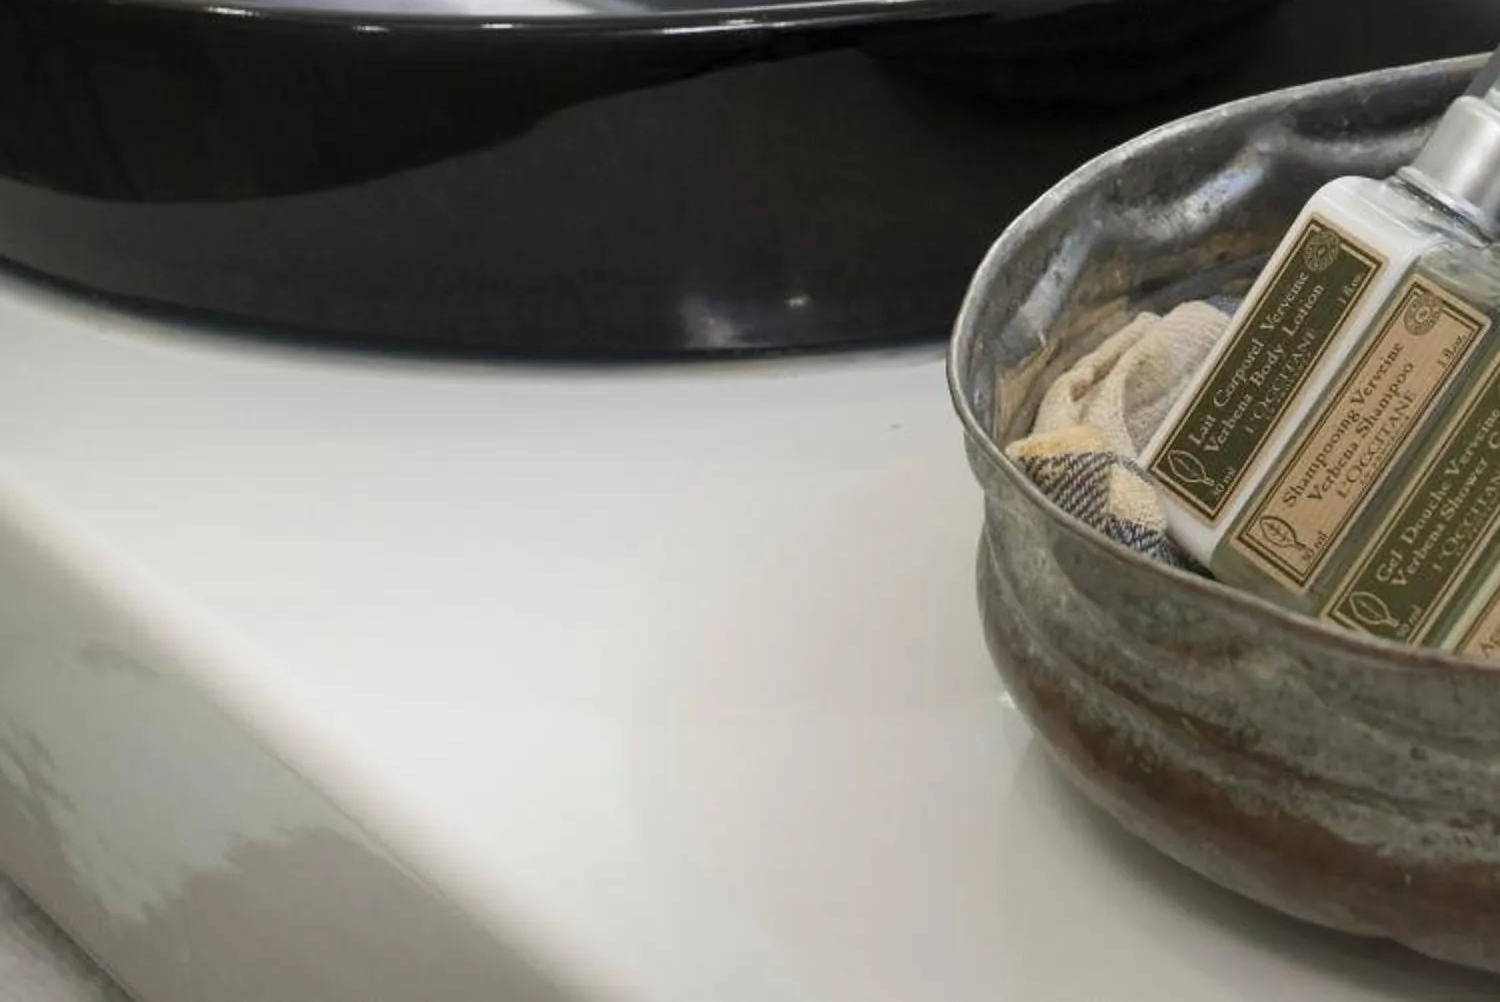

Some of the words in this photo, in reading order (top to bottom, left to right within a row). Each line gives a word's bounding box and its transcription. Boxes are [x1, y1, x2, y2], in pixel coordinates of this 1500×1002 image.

[1204, 392, 1251, 454] Verbena
[1250, 343, 1285, 389] Body
[1281, 284, 1325, 337] Lotion
[1213, 338, 1265, 408] Corporel
[1259, 272, 1309, 332] Verveine
[1282, 409, 1361, 508] Shampooing
[1350, 342, 1404, 407] Verveine
[1306, 439, 1359, 502] Verbena
[1355, 362, 1415, 439] Shampoo
[1375, 550, 1404, 582] Gel
[1401, 482, 1452, 546] Douche
[1444, 409, 1500, 477] Verveine
[1391, 522, 1444, 587] Verbena
[1440, 458, 1488, 521] Shower
